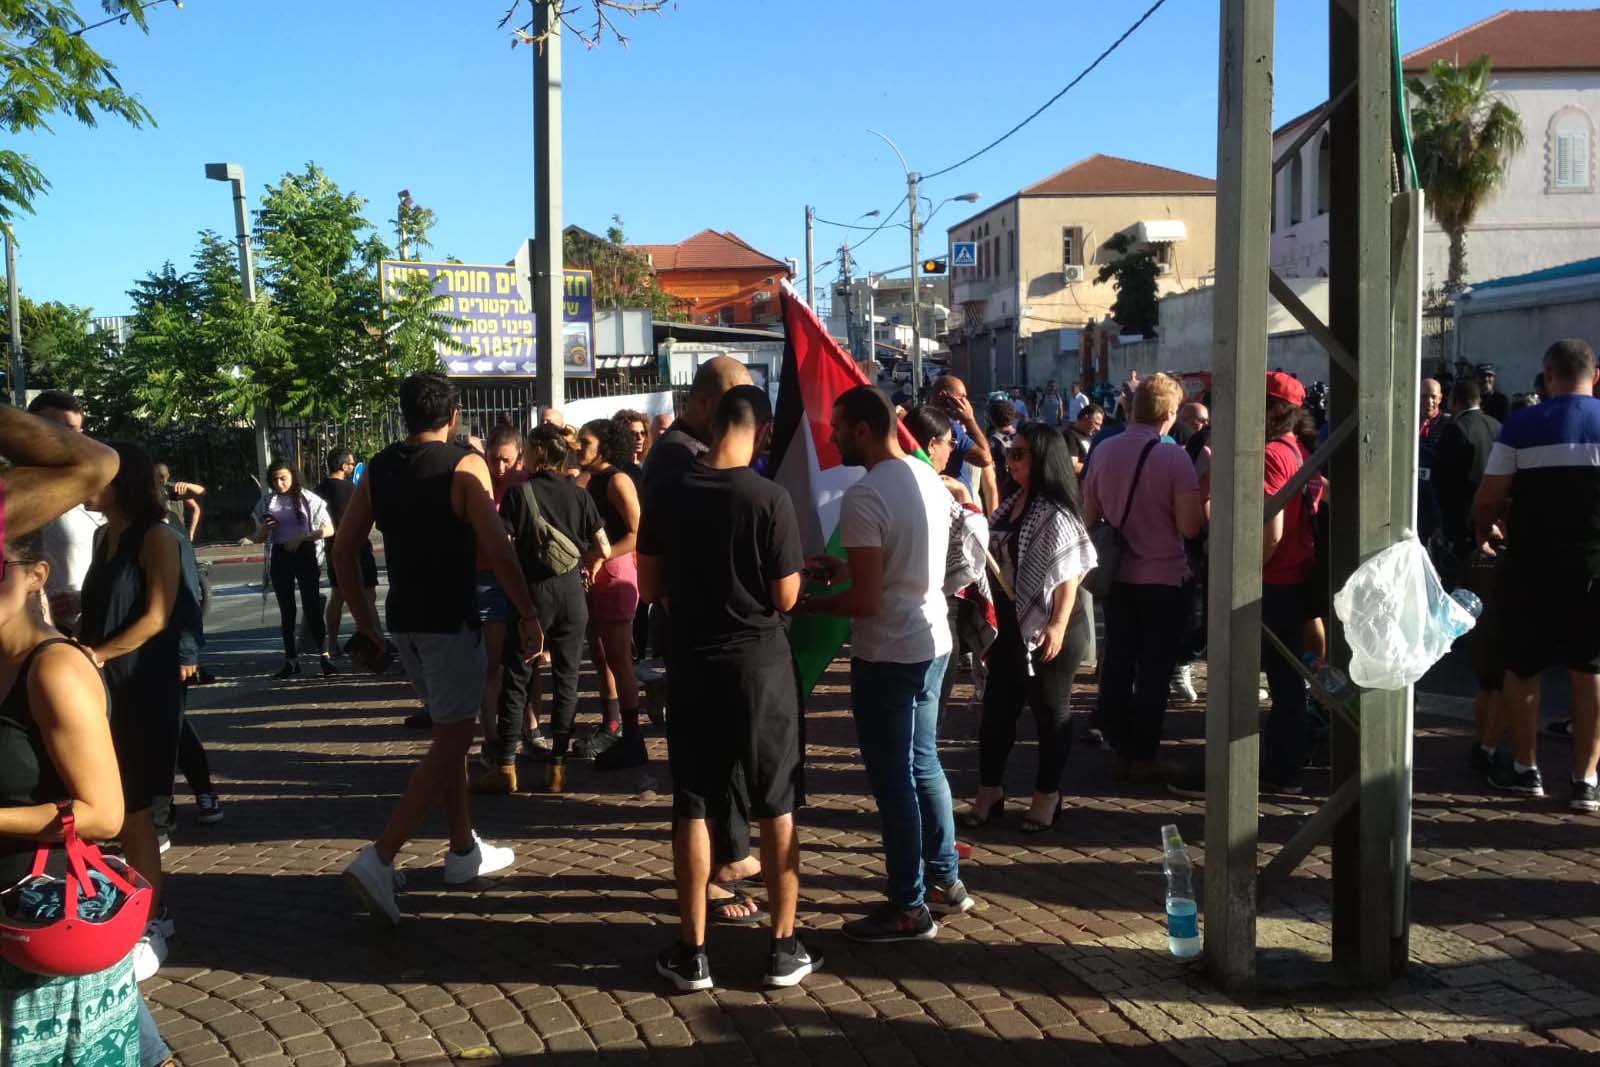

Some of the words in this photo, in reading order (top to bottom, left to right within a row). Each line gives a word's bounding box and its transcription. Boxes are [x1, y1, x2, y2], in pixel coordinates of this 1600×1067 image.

[436, 269, 490, 293] חומרי
[457, 297, 530, 317] טרקטורים
[502, 319, 533, 334] פינוי
[440, 336, 536, 357] 03-518377
